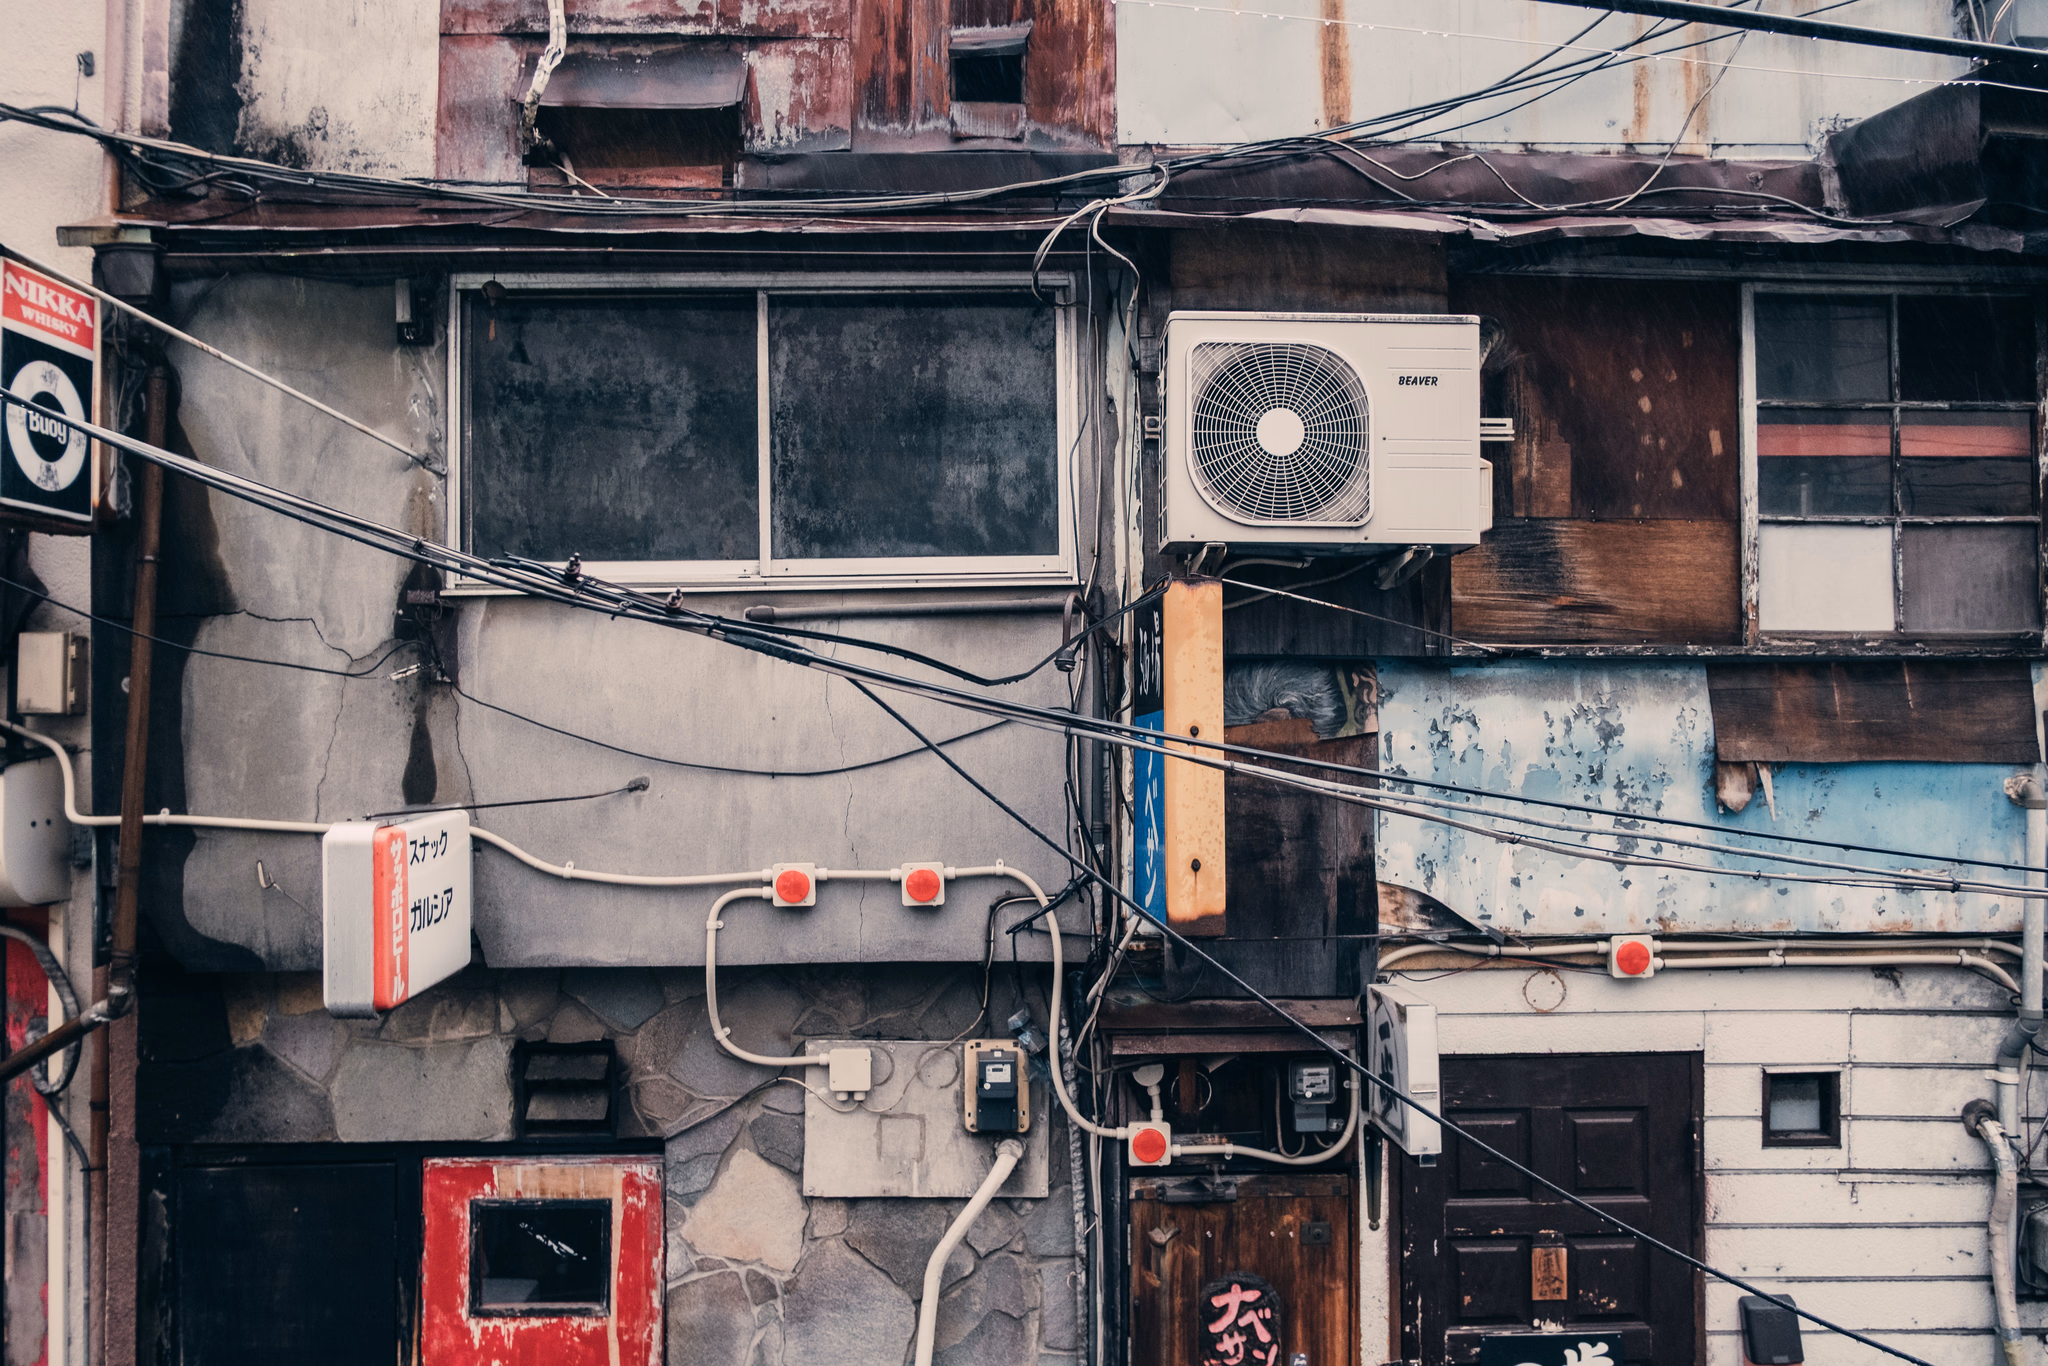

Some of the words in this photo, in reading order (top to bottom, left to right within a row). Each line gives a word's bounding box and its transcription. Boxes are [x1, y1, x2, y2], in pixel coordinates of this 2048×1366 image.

[4, 270, 94, 328] NIKKA
[20, 304, 79, 338] WHISKY
[1398, 375, 1439, 387] BEAVER
[28, 411, 68, 445] Buoy
[1144, 720, 1160, 909] ナベサン
[409, 829, 448, 866] スナック
[389, 837, 406, 1004] サッポロビール
[410, 886, 453, 934] ガルシア
